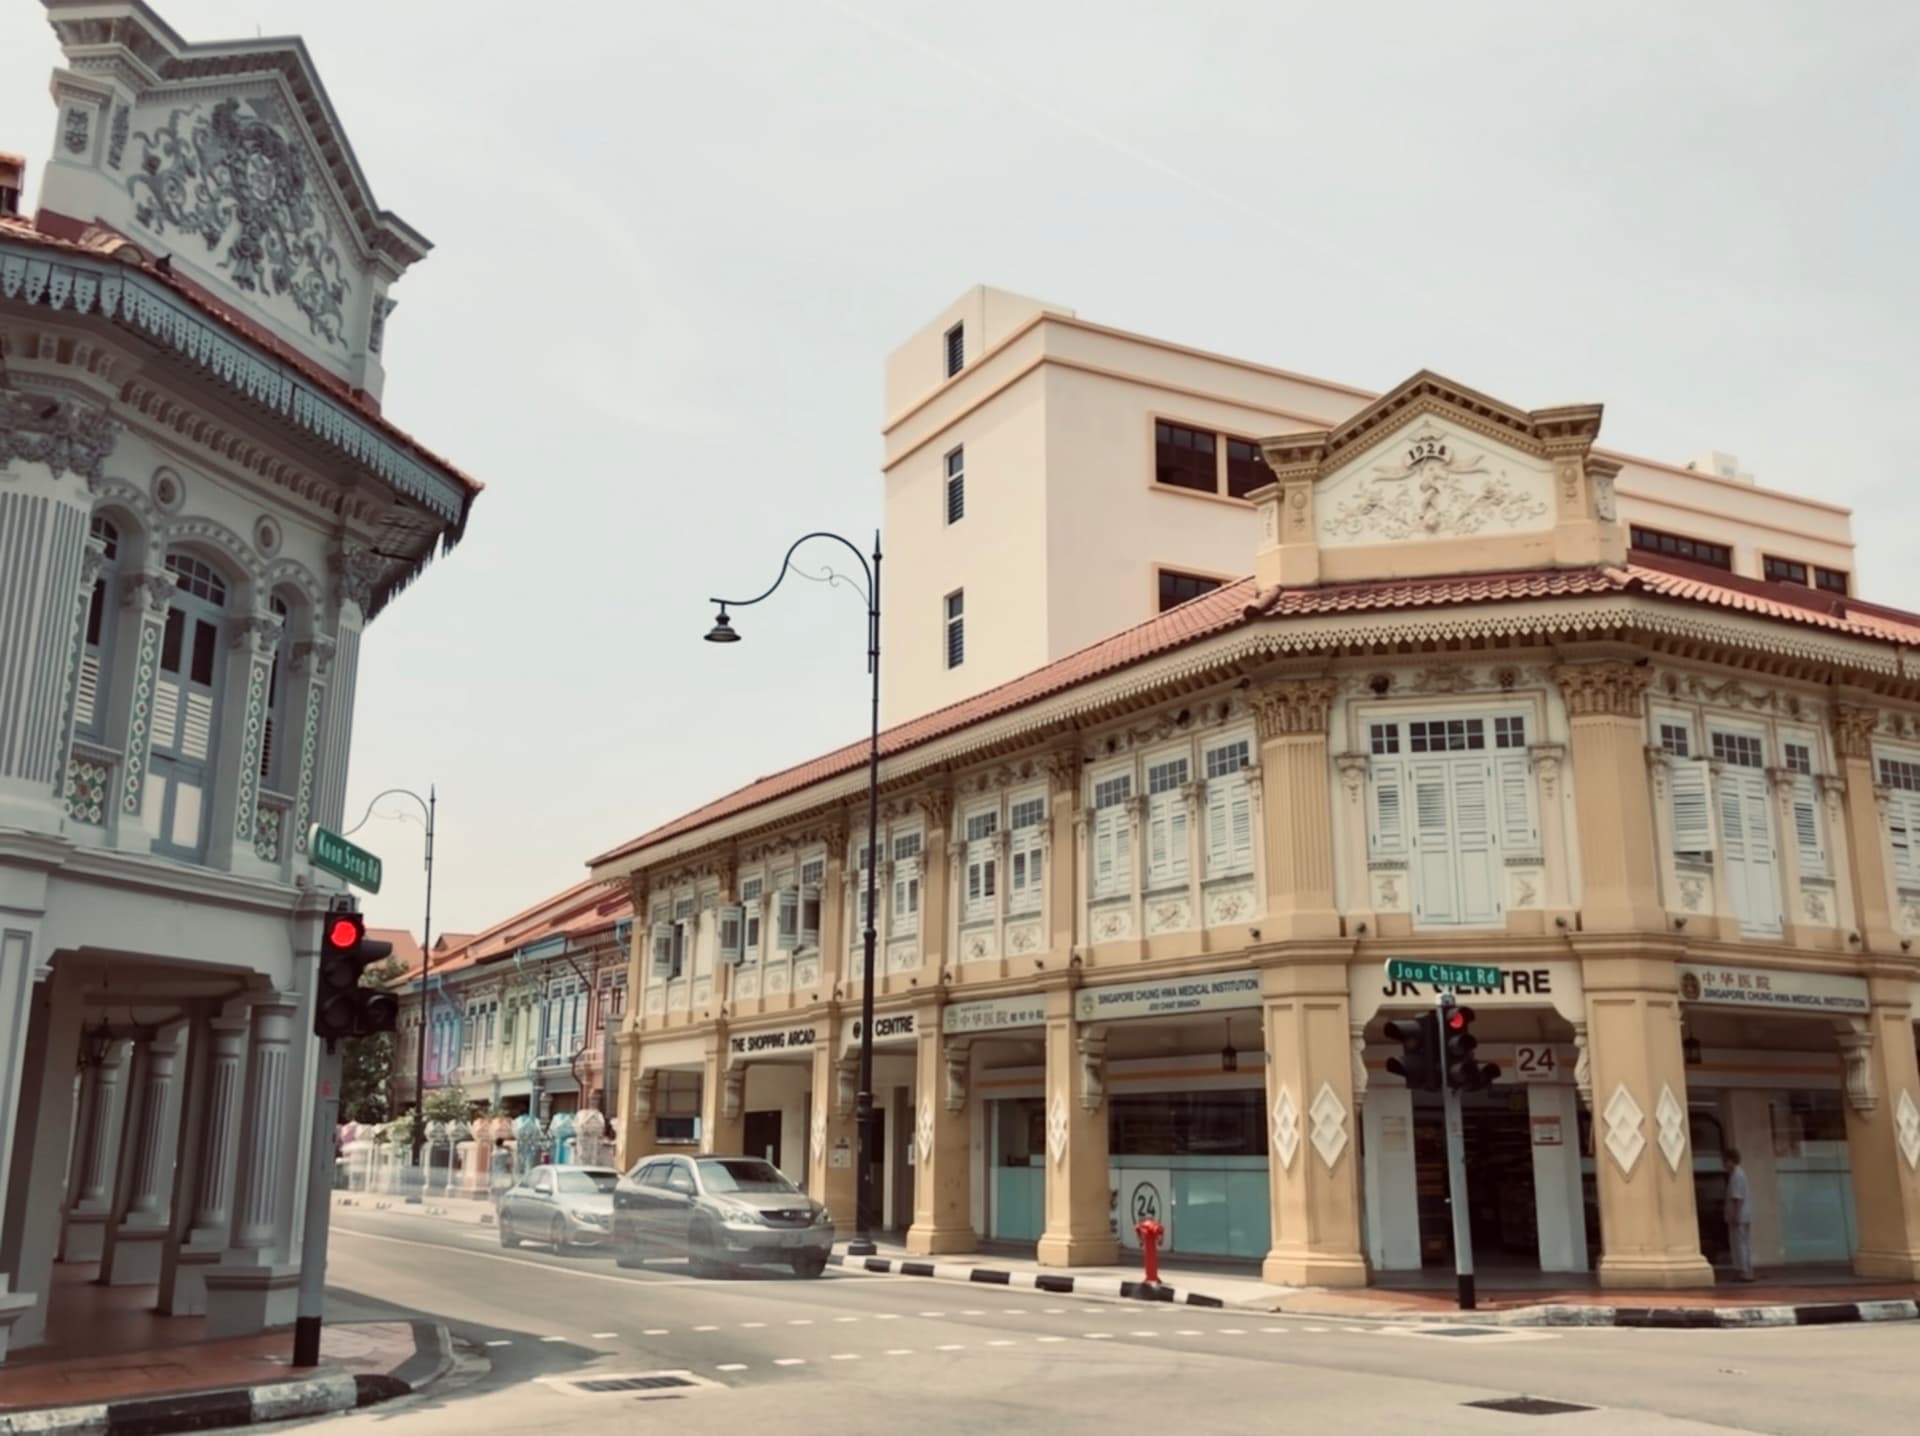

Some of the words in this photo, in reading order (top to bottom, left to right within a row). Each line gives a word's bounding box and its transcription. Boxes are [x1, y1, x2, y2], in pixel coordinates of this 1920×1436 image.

[318, 831, 343, 864] Koon
[344, 846, 366, 882] Seng
[367, 858, 379, 883] Rd
[1396, 963, 1423, 979] Joo
[1429, 965, 1470, 983] Chiat
[1477, 969, 1496, 985] Rd
[1702, 971, 1771, 990] 中华医院
[1098, 991, 1134, 1005] SINGAPORE
[1136, 988, 1160, 1000] CHUNG
[1161, 986, 1176, 997] HWA
[1179, 983, 1210, 996] MEDICAL
[1211, 978, 1259, 992] INSTITUTION
[1383, 978, 1421, 997] JK
[1704, 988, 1746, 1000] SINGAPORE
[1747, 991, 1773, 1002] CHUNG
[1774, 993, 1790, 1003] HWA
[1792, 994, 1823, 1005] MEDICAL
[1824, 996, 1866, 1008] INSTITUTION
[875, 1015, 914, 1036] CENTRE
[731, 1037, 745, 1053] THE
[748, 1032, 785, 1051] SHOPPING
[787, 1028, 816, 1046] ARCAD
[1518, 1047, 1555, 1072] 24
[1137, 1194, 1156, 1217] 24
